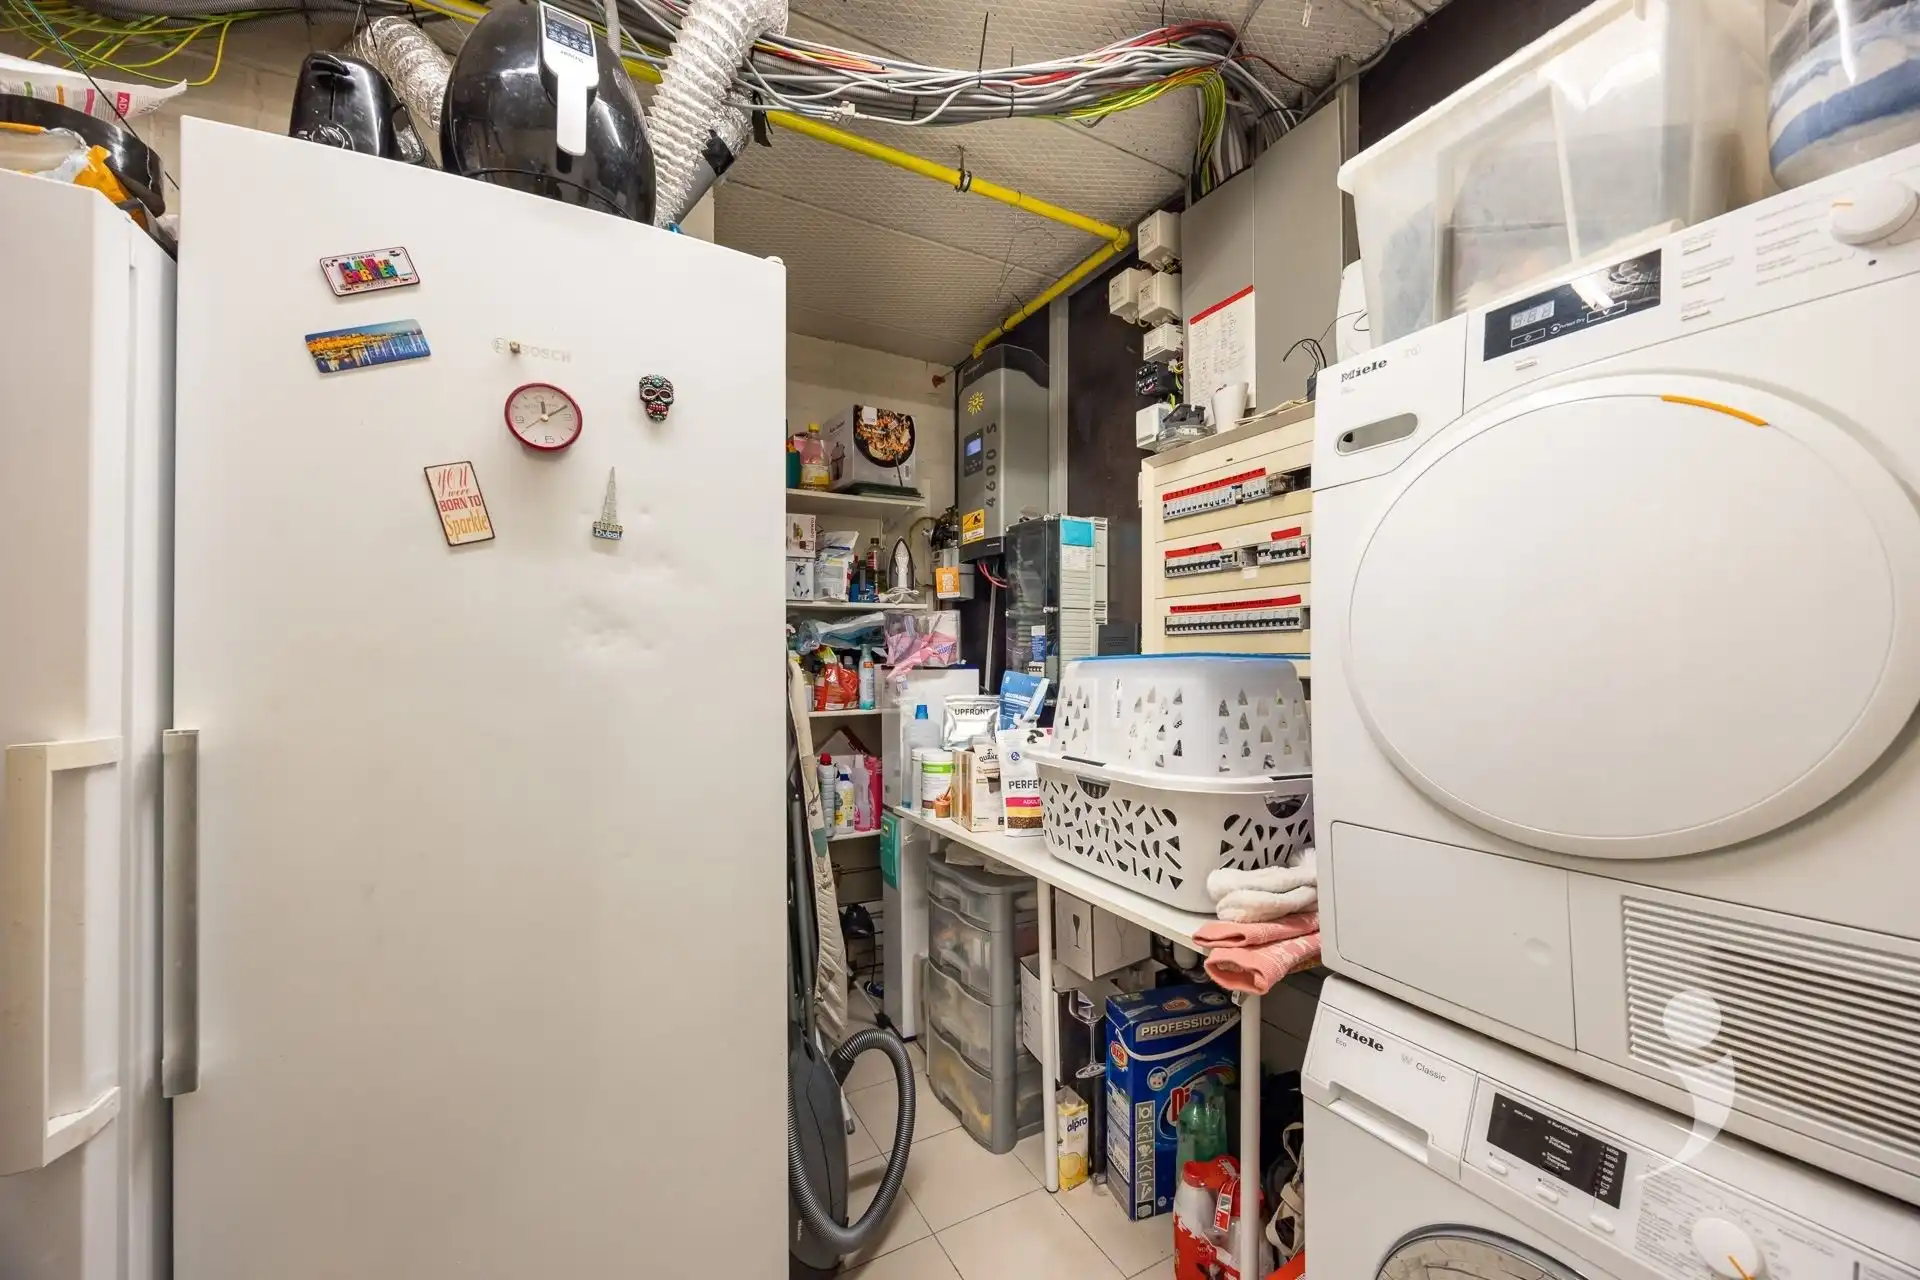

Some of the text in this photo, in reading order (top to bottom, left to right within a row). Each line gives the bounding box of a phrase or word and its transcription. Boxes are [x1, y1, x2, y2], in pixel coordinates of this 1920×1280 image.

[520, 344, 572, 363] BOSCH
[1340, 359, 1388, 384] Miele
[439, 495, 482, 513] BORN TO
[444, 509, 489, 541] Sparkle
[954, 708, 990, 716] UPFRONT
[979, 754, 998, 763] QUAKE
[1008, 780, 1038, 790] PERFE
[1337, 1023, 1384, 1052] Miele
[1415, 1061, 1446, 1082] Classic
[1066, 1116, 1088, 1133] alpro
